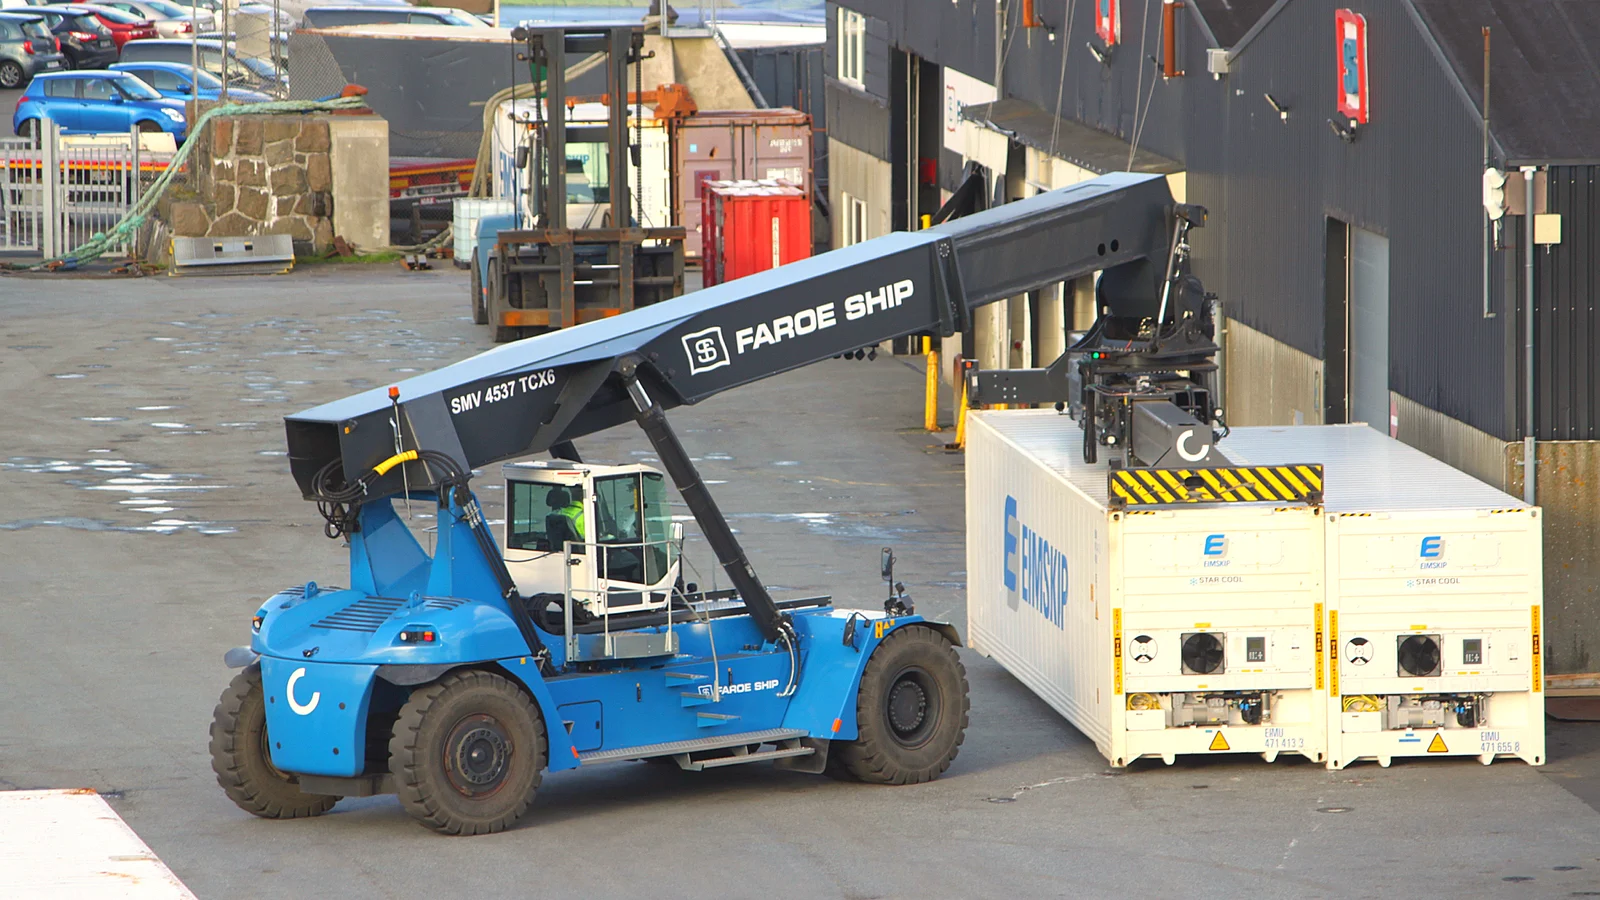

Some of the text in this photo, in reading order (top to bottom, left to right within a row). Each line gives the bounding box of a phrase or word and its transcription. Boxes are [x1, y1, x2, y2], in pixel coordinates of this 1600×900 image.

[735, 279, 914, 354] FAROE SHIP
[451, 368, 556, 415] SMV 4537 TCX6
[1022, 524, 1068, 631] EIMSKIP
[754, 679, 779, 691] SHIP
[1265, 728, 1284, 737] EIMU
[1481, 731, 1500, 741] EIMU
[1265, 738, 1279, 748] 471
[1282, 738, 1296, 748] 413
[1481, 741, 1520, 752] 471 655 8
